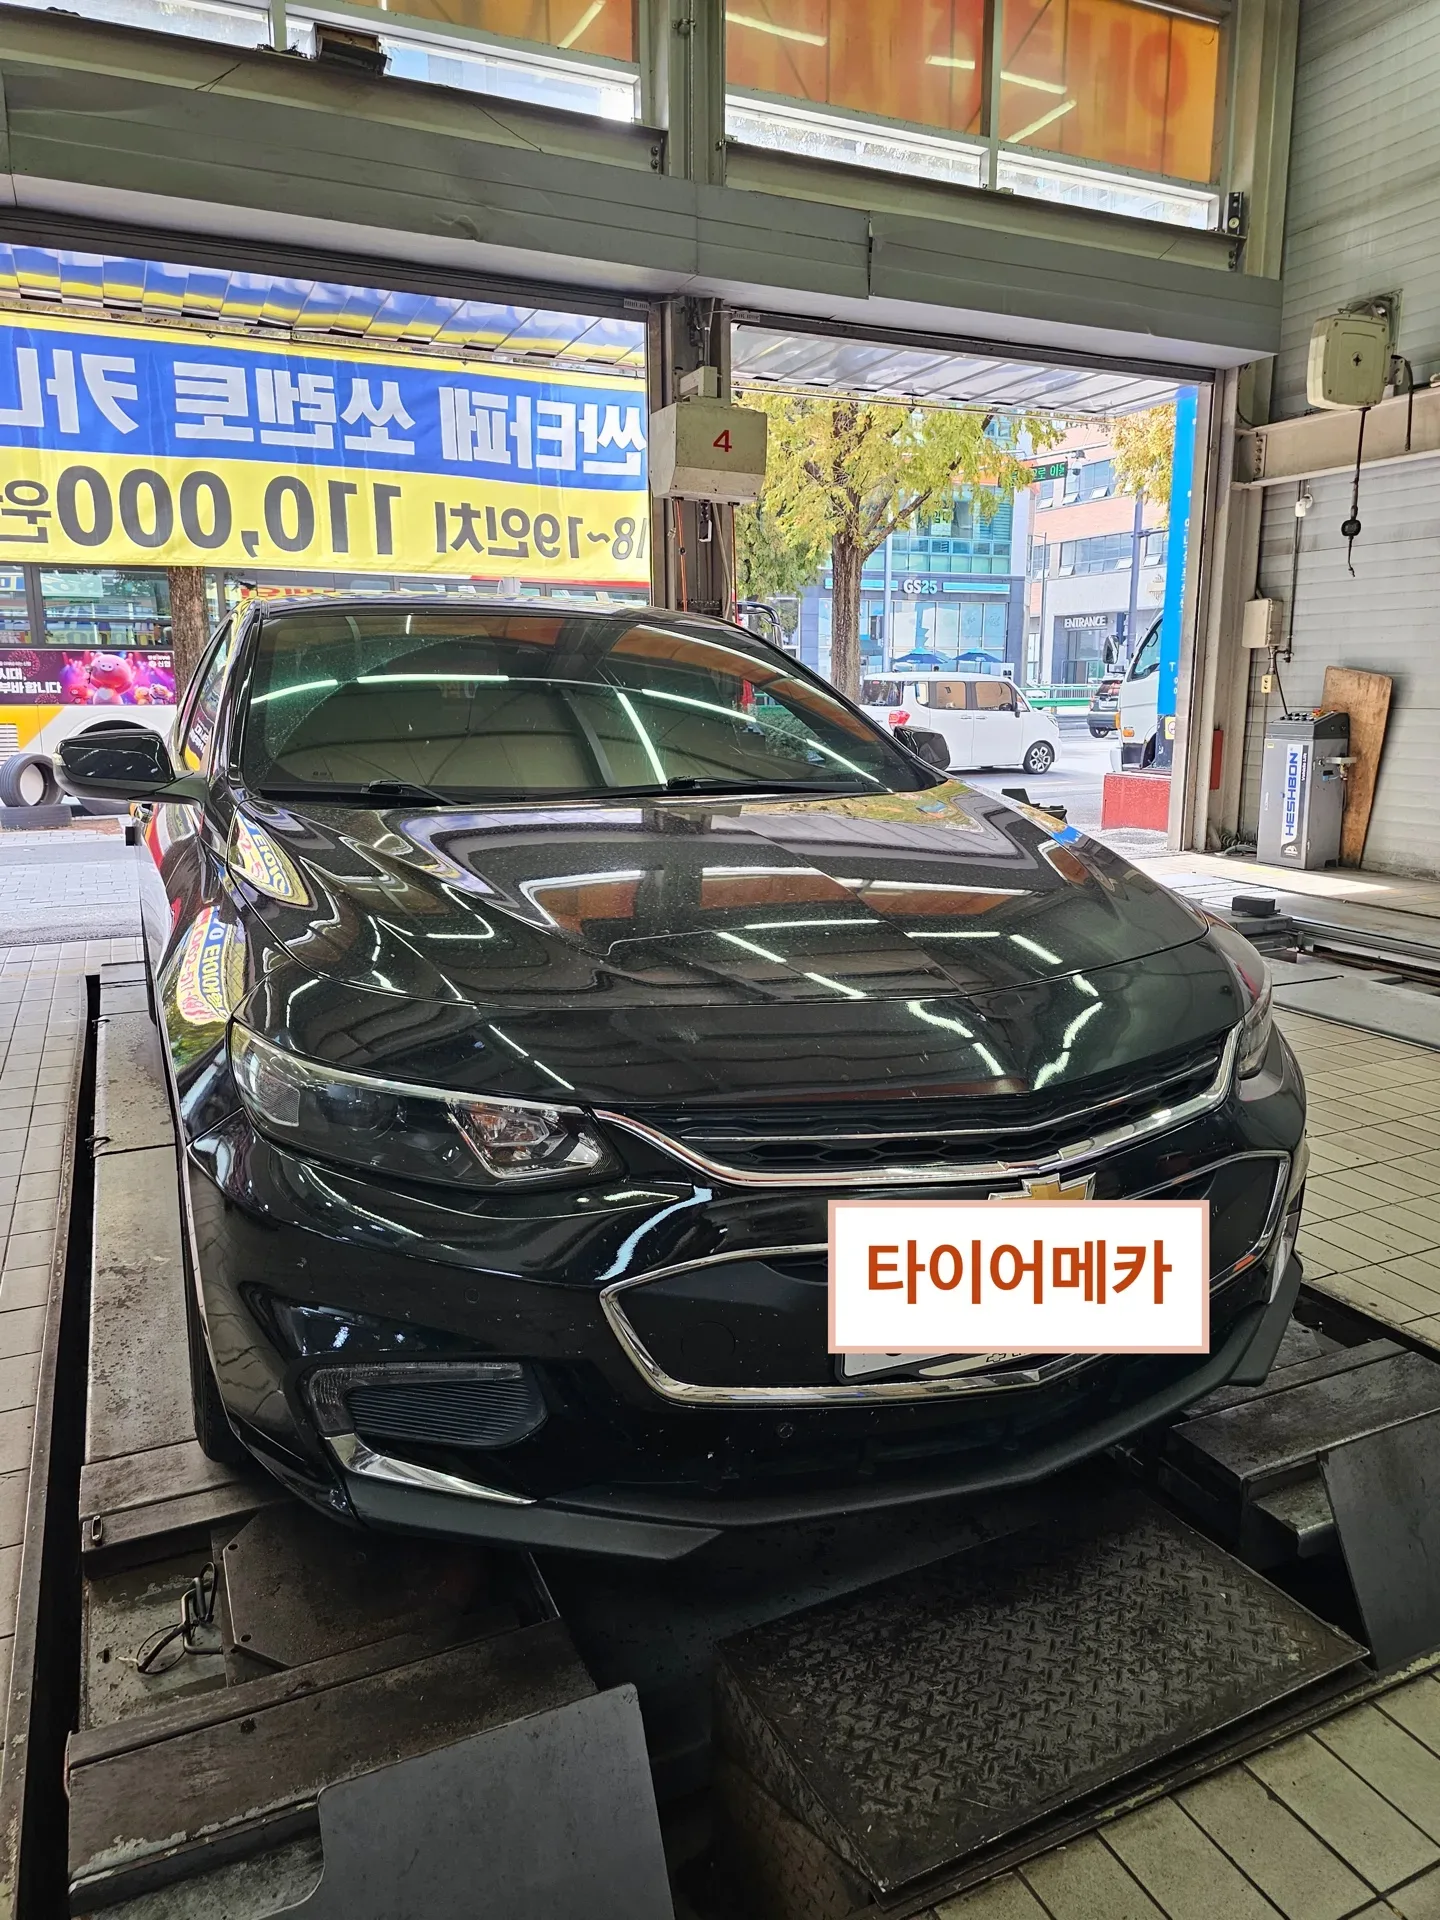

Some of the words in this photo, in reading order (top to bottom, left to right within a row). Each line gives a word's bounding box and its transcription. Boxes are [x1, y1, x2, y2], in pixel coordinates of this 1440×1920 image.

[713, 430, 732, 452] 4
[903, 579, 938, 595] GS25
[1064, 616, 1107, 628] ENTRANCE
[1286, 752, 1298, 836] HESHBON
